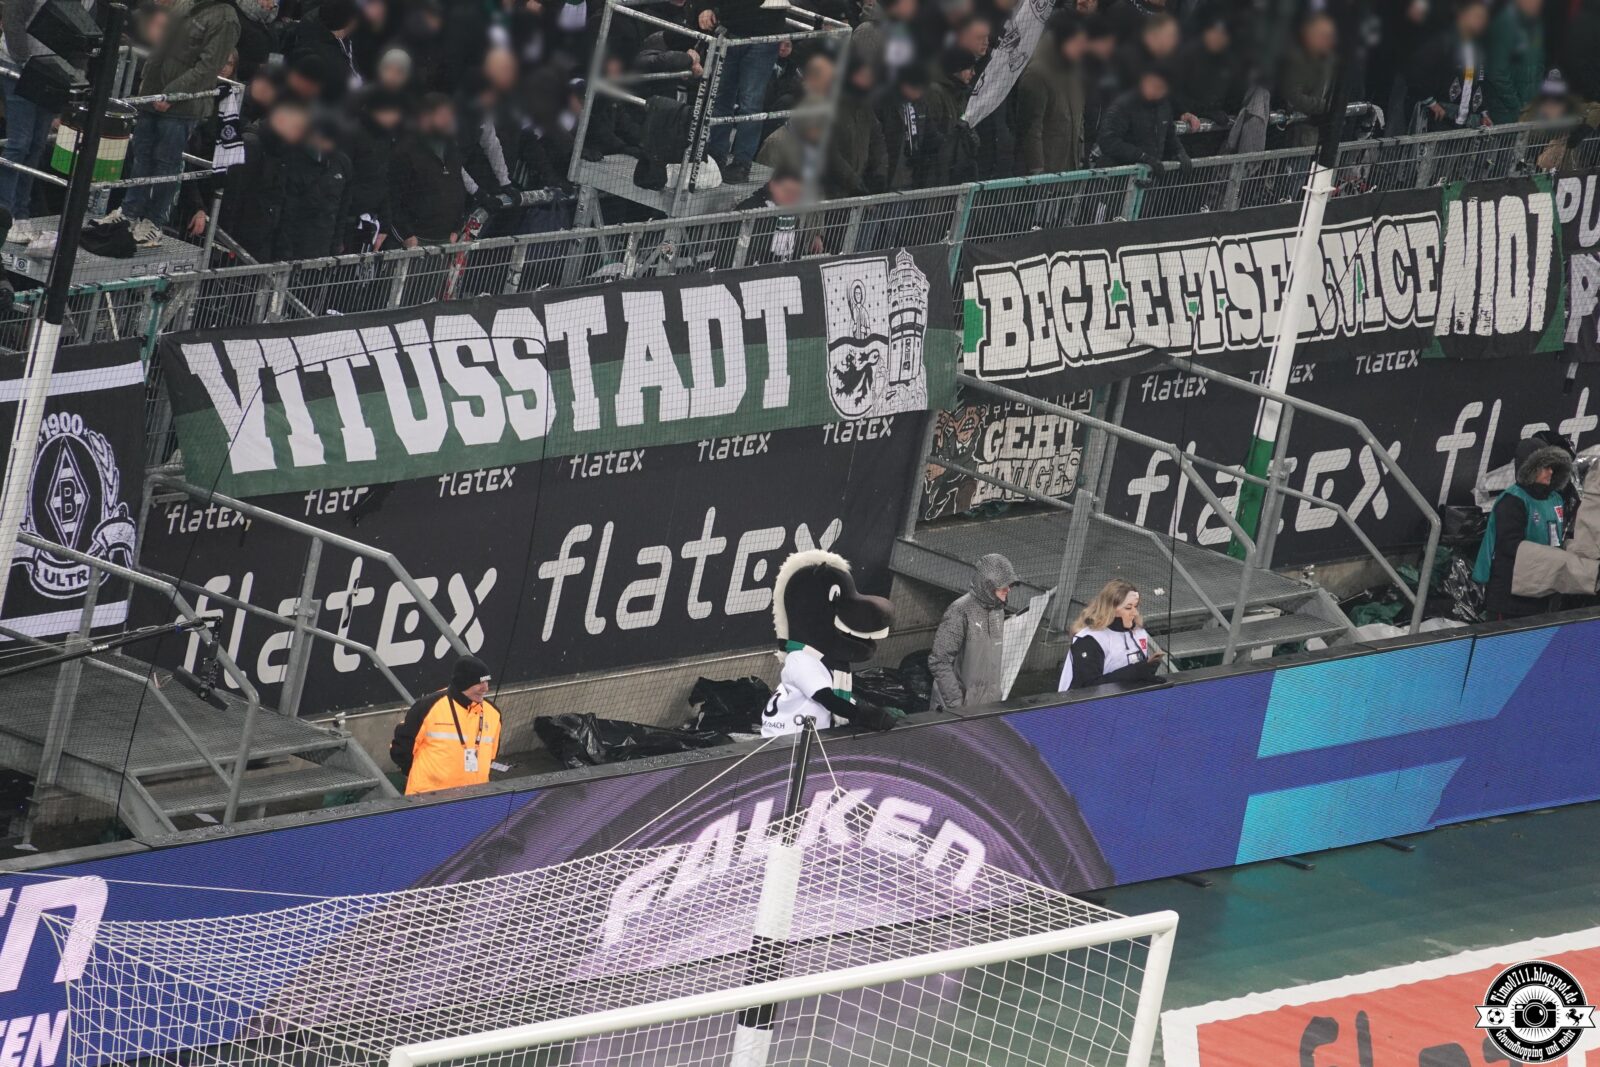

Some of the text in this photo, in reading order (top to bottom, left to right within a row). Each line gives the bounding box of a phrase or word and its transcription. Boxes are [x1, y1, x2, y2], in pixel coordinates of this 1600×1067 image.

[181, 276, 803, 475] VITUSSTADT
[41, 412, 83, 437] 1900
[984, 414, 1075, 462] GEHT
[44, 569, 90, 587] ULTR
